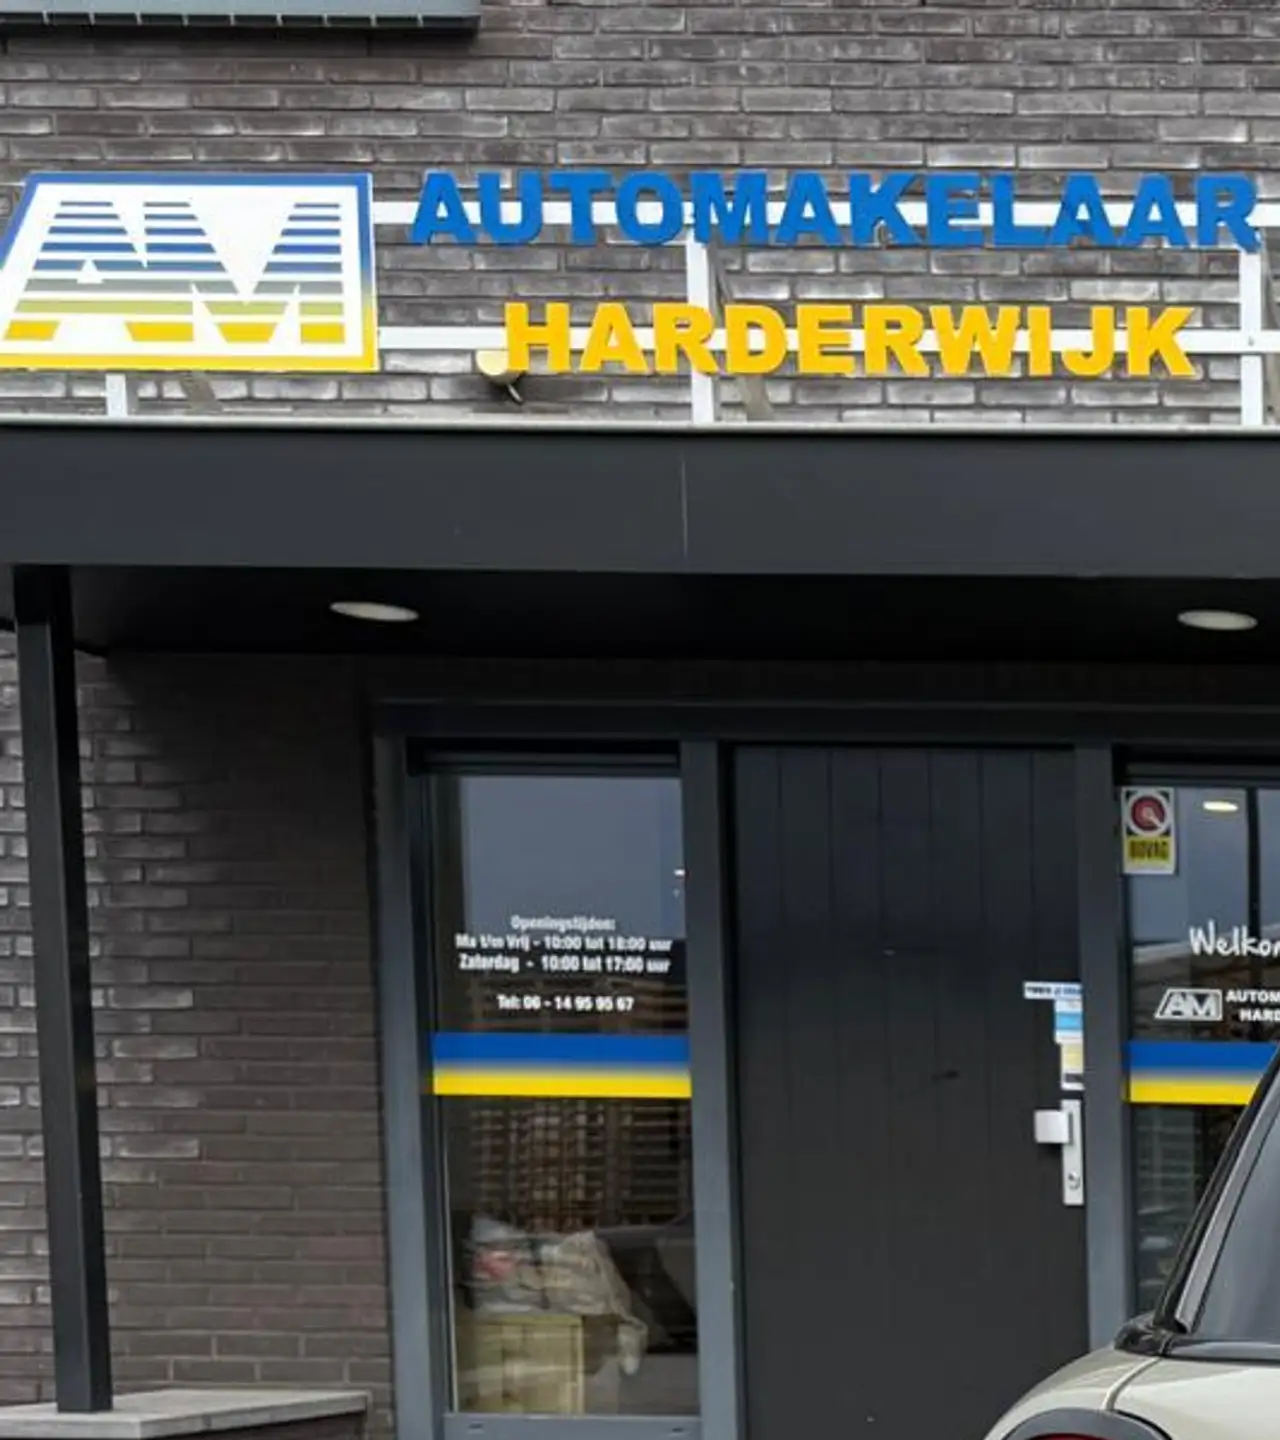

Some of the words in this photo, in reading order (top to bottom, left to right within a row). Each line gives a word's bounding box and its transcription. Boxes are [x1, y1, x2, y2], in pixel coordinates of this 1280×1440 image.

[407, 169, 1261, 253] AUTOMAKELAAR
[503, 302, 1200, 378] HARDERWIJK
[510, 915, 616, 932] Openingstijden:
[455, 933, 476, 949] Ma
[480, 934, 505, 949] t/m
[506, 935, 530, 951] Vrij
[544, 936, 582, 950] 10:00
[585, 936, 604, 950] tot
[608, 937, 646, 951] 18:00
[649, 939, 673, 951] uur
[458, 953, 520, 973] Zaterdag
[541, 955, 580, 971] 10:00
[583, 956, 603, 971] tot
[606, 957, 643, 972] 17:00
[647, 959, 671, 973] uur
[497, 995, 520, 1010] Tel:
[523, 995, 542, 1010] 06
[554, 996, 573, 1011] 14
[617, 997, 635, 1011] 67
